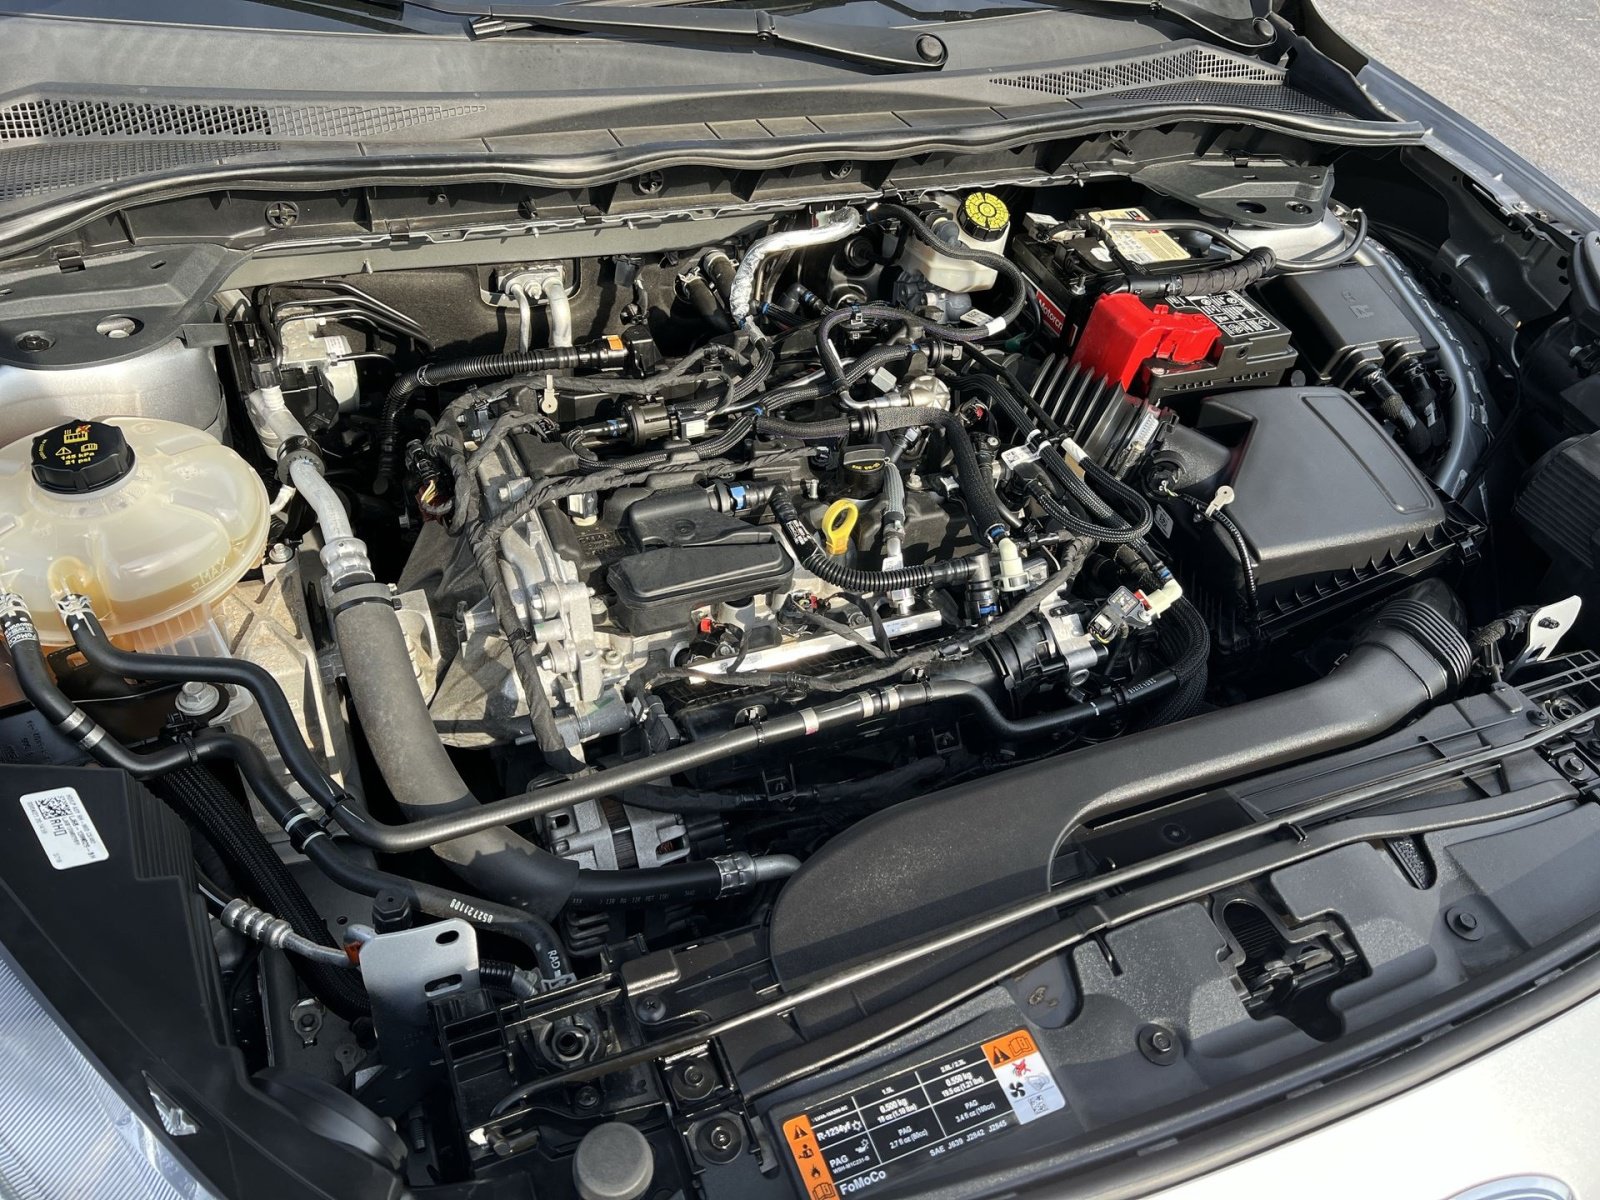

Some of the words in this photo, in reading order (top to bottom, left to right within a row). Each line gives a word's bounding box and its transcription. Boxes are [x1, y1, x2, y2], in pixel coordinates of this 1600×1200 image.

[1039, 299, 1064, 331] Motorcr
[547, 949, 561, 969] RAD
[962, 1071, 973, 1081] kg
[897, 1098, 908, 1107] kg
[964, 1099, 979, 1110] PAG
[816, 1121, 851, 1142] R-1234yf
[898, 1125, 912, 1136] PAG
[929, 1144, 946, 1157] SAE
[829, 1154, 849, 1168] PAG
[839, 1170, 887, 1195] FoMoCo
